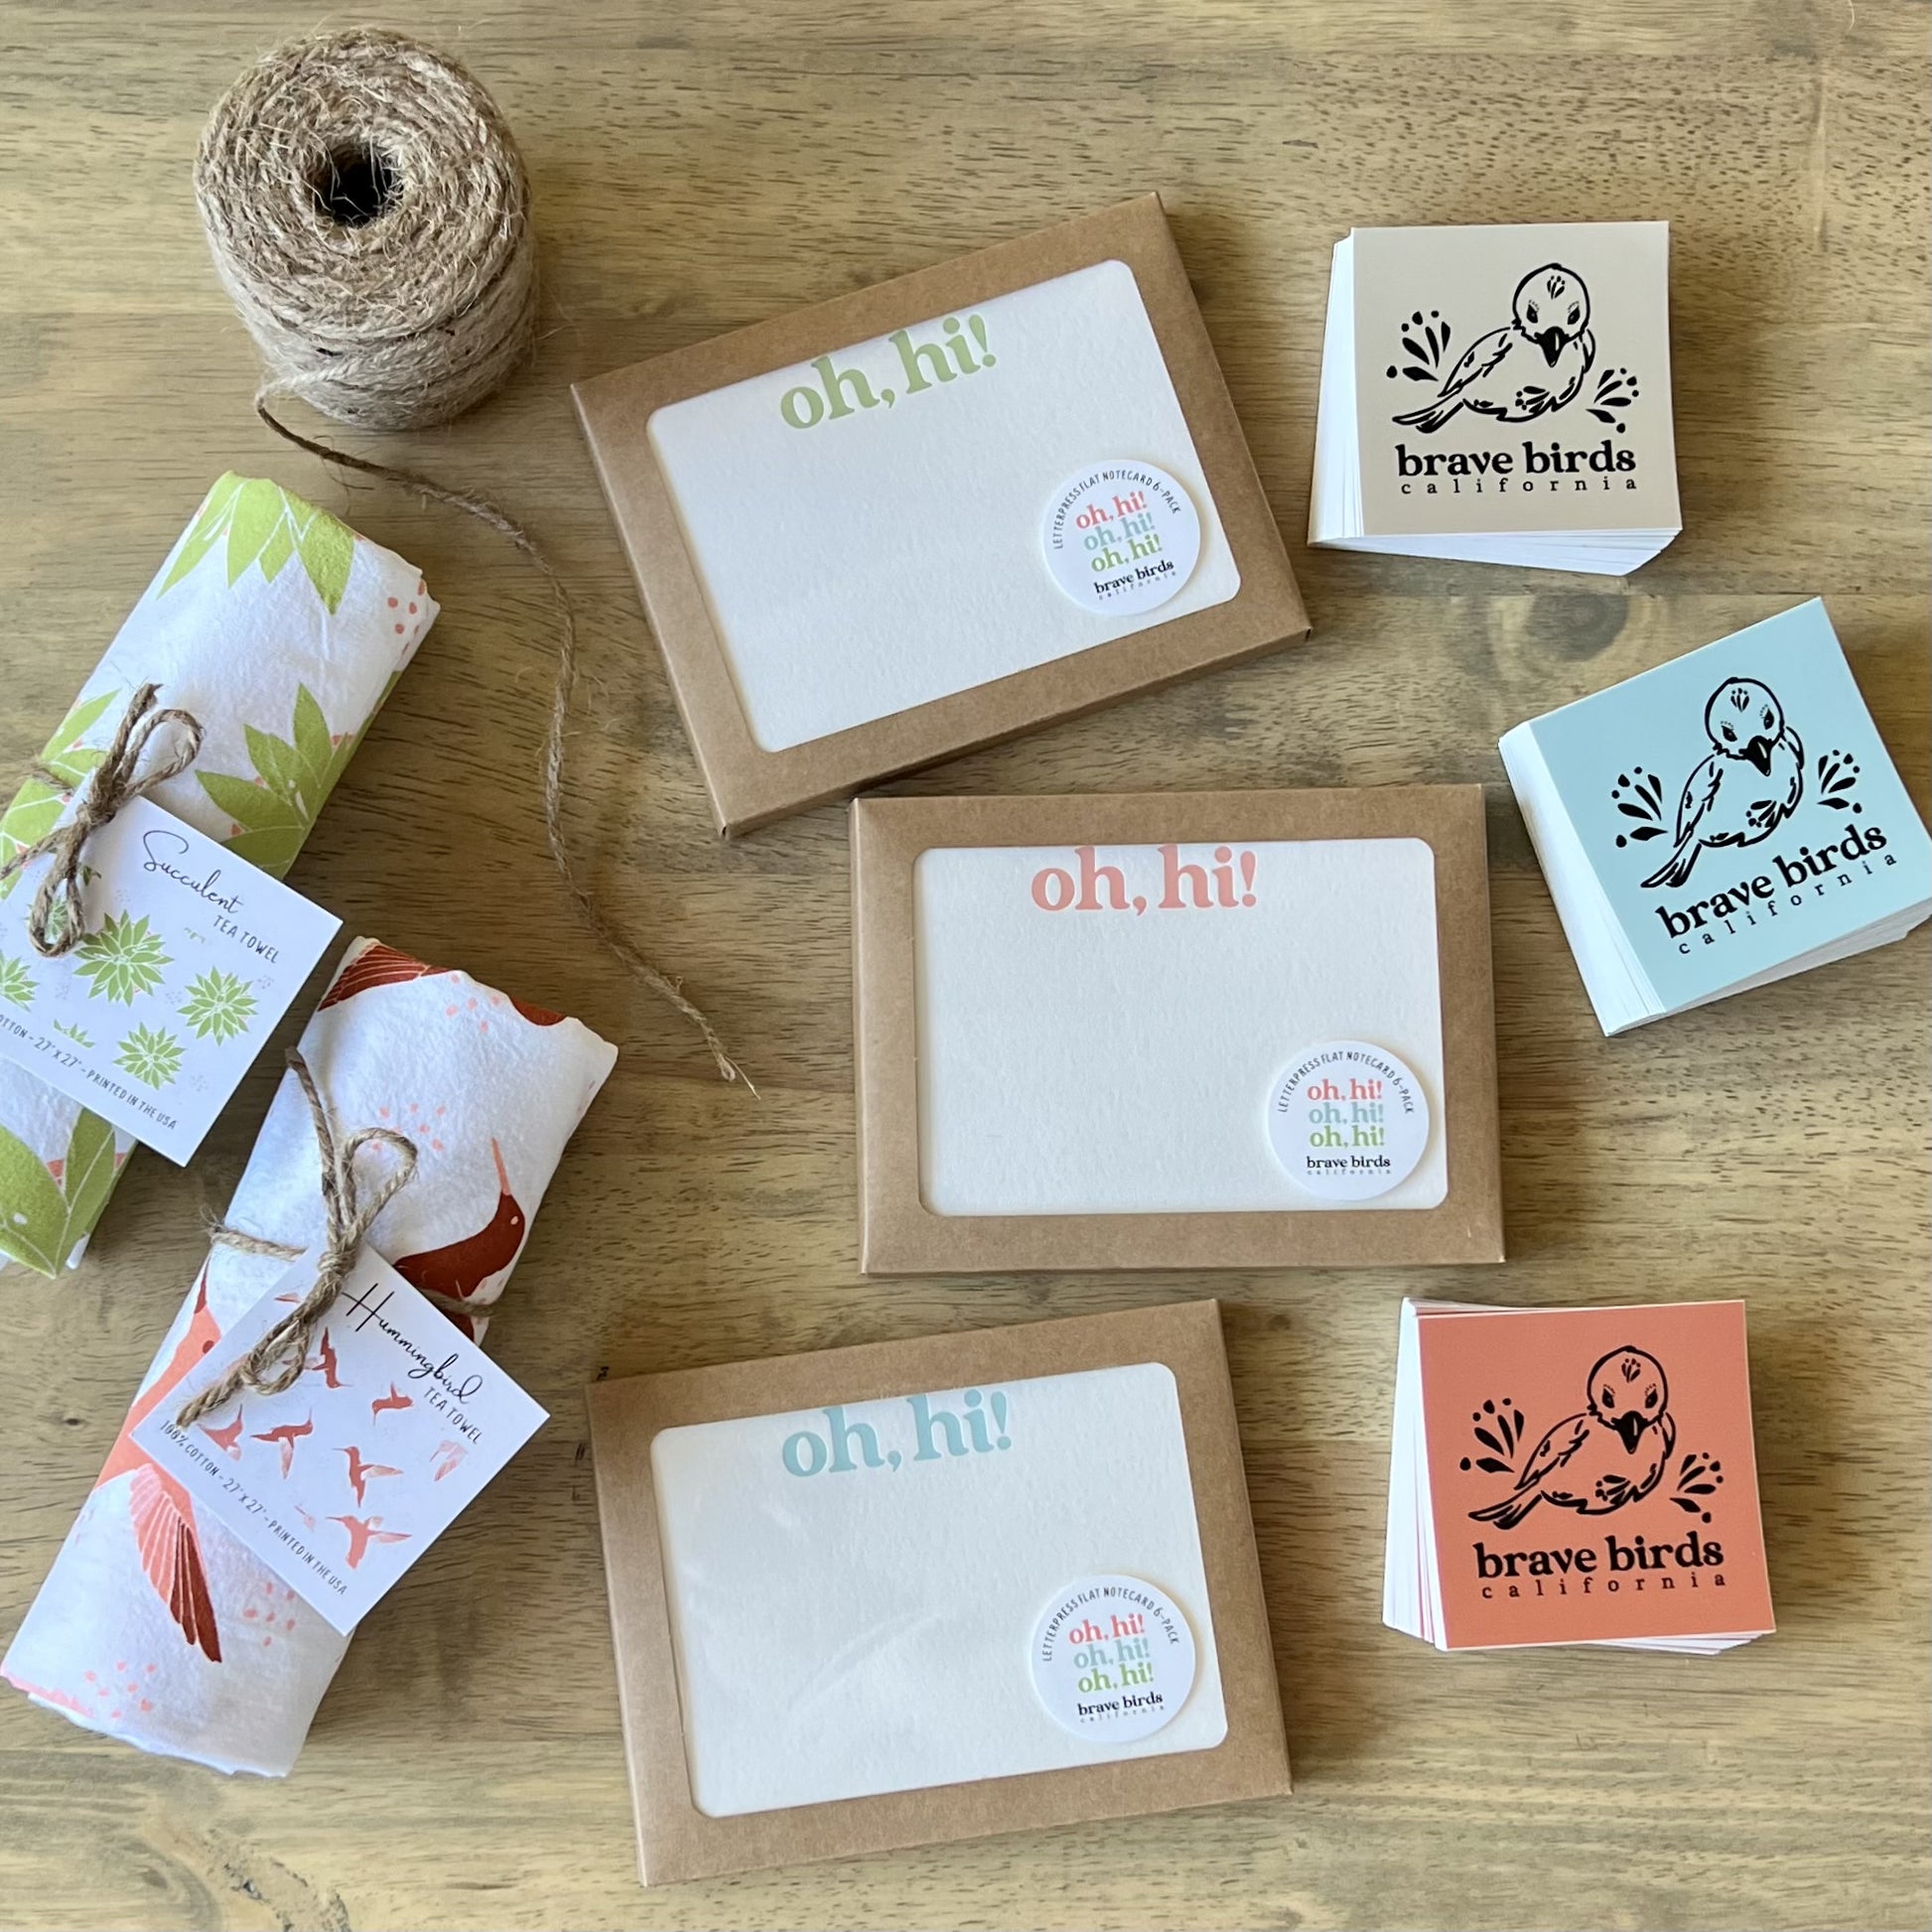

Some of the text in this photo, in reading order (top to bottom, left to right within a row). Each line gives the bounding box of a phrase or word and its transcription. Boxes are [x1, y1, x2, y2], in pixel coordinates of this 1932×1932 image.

[780, 314, 997, 429] oh, hi!
[1395, 440, 1636, 477] brave birds
[1401, 478, 1637, 494] california
[1052, 470, 1180, 549] LETTERPRESS FLAT NOTECARD 6-PACK
[1076, 491, 1147, 528] oh, hi!
[1084, 512, 1155, 550] oh, hi!
[1091, 534, 1163, 572] oh, hi!
[1094, 559, 1173, 594] brave birds
[1099, 571, 1175, 600] california
[143, 830, 244, 913] Succulent
[1032, 844, 1256, 915] oh, hi!
[1654, 823, 1887, 938] brave birds
[1679, 854, 1897, 954] california
[213, 915, 279, 964] TEA TOWEL
[86, 1069, 127, 1100] PRINTED
[127, 1094, 138, 1106] IN
[139, 1101, 157, 1118] THE
[156, 1113, 177, 1130] USA
[1278, 1051, 1414, 1113] LETTERPRESS FLAT NOTECARD 6-PACK
[1308, 1078, 1382, 1101] oh, hi!
[1309, 1102, 1384, 1124] oh, hi!
[1310, 1125, 1385, 1148] oh, hi!
[1307, 1155, 1391, 1169] brave birds
[342, 1284, 483, 1404] Hummingbird
[424, 1387, 483, 1445] TEA TOWEL
[782, 1390, 1012, 1476] oh, hi!
[160, 1421, 189, 1447] 100%
[185, 1444, 219, 1476] COTTON
[268, 1520, 303, 1556] PRINTED
[302, 1552, 313, 1565] IN
[313, 1562, 331, 1580] THE
[328, 1576, 347, 1595] USA
[1473, 1530, 1724, 1579] brave birds
[1482, 1574, 1725, 1598] california
[1042, 1587, 1179, 1661] LETTERPRESS FLAT NOTECARD 6-PACK
[1069, 1613, 1145, 1644] oh, hi!
[1073, 1638, 1151, 1668] oh, hi!
[1077, 1662, 1154, 1693] oh, hi!
[1078, 1692, 1163, 1716] brave birds
[1080, 1706, 1164, 1723] california
